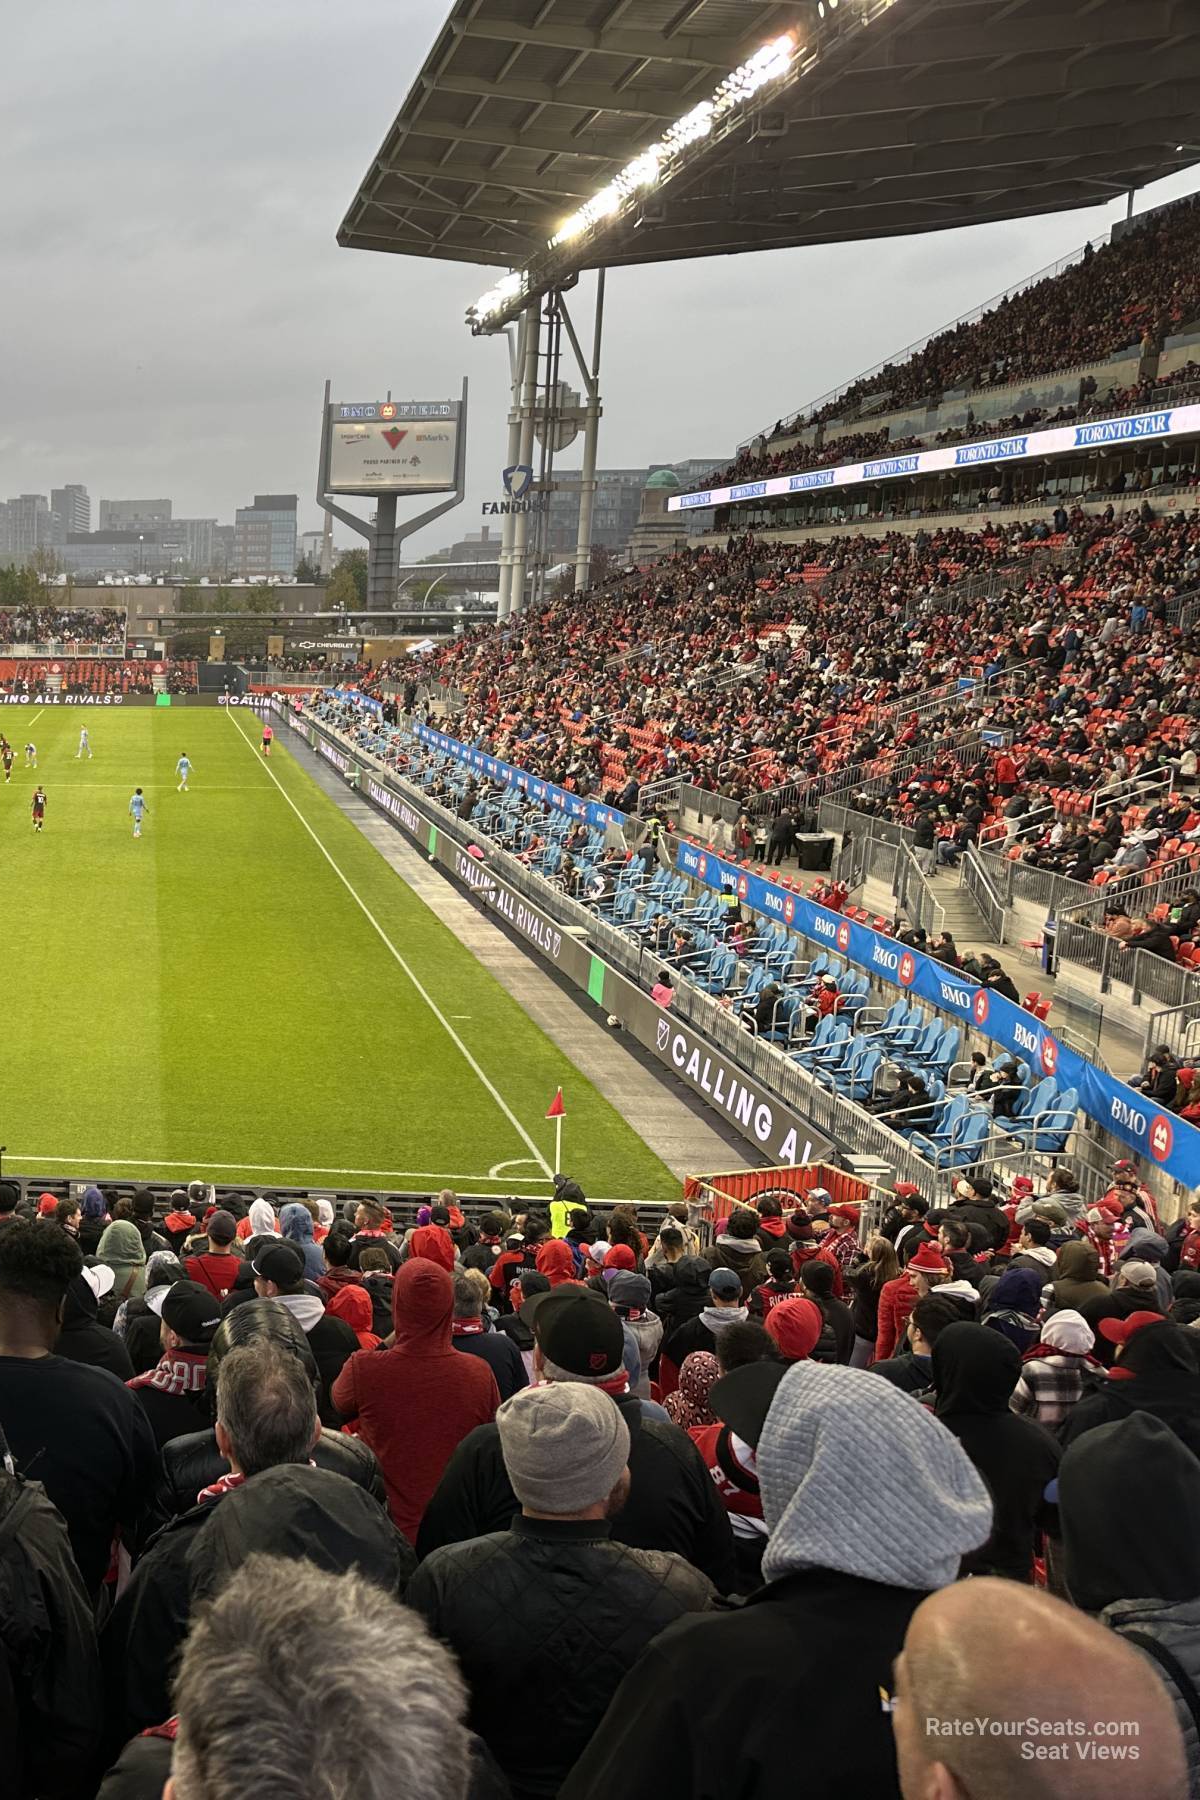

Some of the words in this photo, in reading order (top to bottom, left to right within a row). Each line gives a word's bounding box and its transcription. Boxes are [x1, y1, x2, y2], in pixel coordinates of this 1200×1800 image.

[341, 406, 375, 417] BMO
[400, 405, 450, 416] FIELD
[1079, 422, 1132, 444] TORONTO
[1133, 415, 1166, 435] STAR
[959, 444, 999, 463] TORONTO
[1000, 440, 1024, 456] STAR
[866, 462, 896, 477] TORONTO
[897, 459, 916, 472] STAR
[34, 694, 60, 704] ALL
[65, 694, 111, 704] RIVALS
[684, 852, 698, 869] BMO
[721, 871, 737, 888] BMO
[765, 892, 783, 912] BMO
[497, 889, 514, 920] ALL
[516, 904, 553, 951] RIVALS
[814, 917, 836, 938] BMO
[872, 946, 897, 970] BMO
[940, 982, 970, 1008] BMO
[1013, 1022, 1038, 1053] BMO
[672, 1034, 773, 1141] CALLING
[1111, 1096, 1147, 1136] BMO
[709, 1465, 741, 1496] 87
